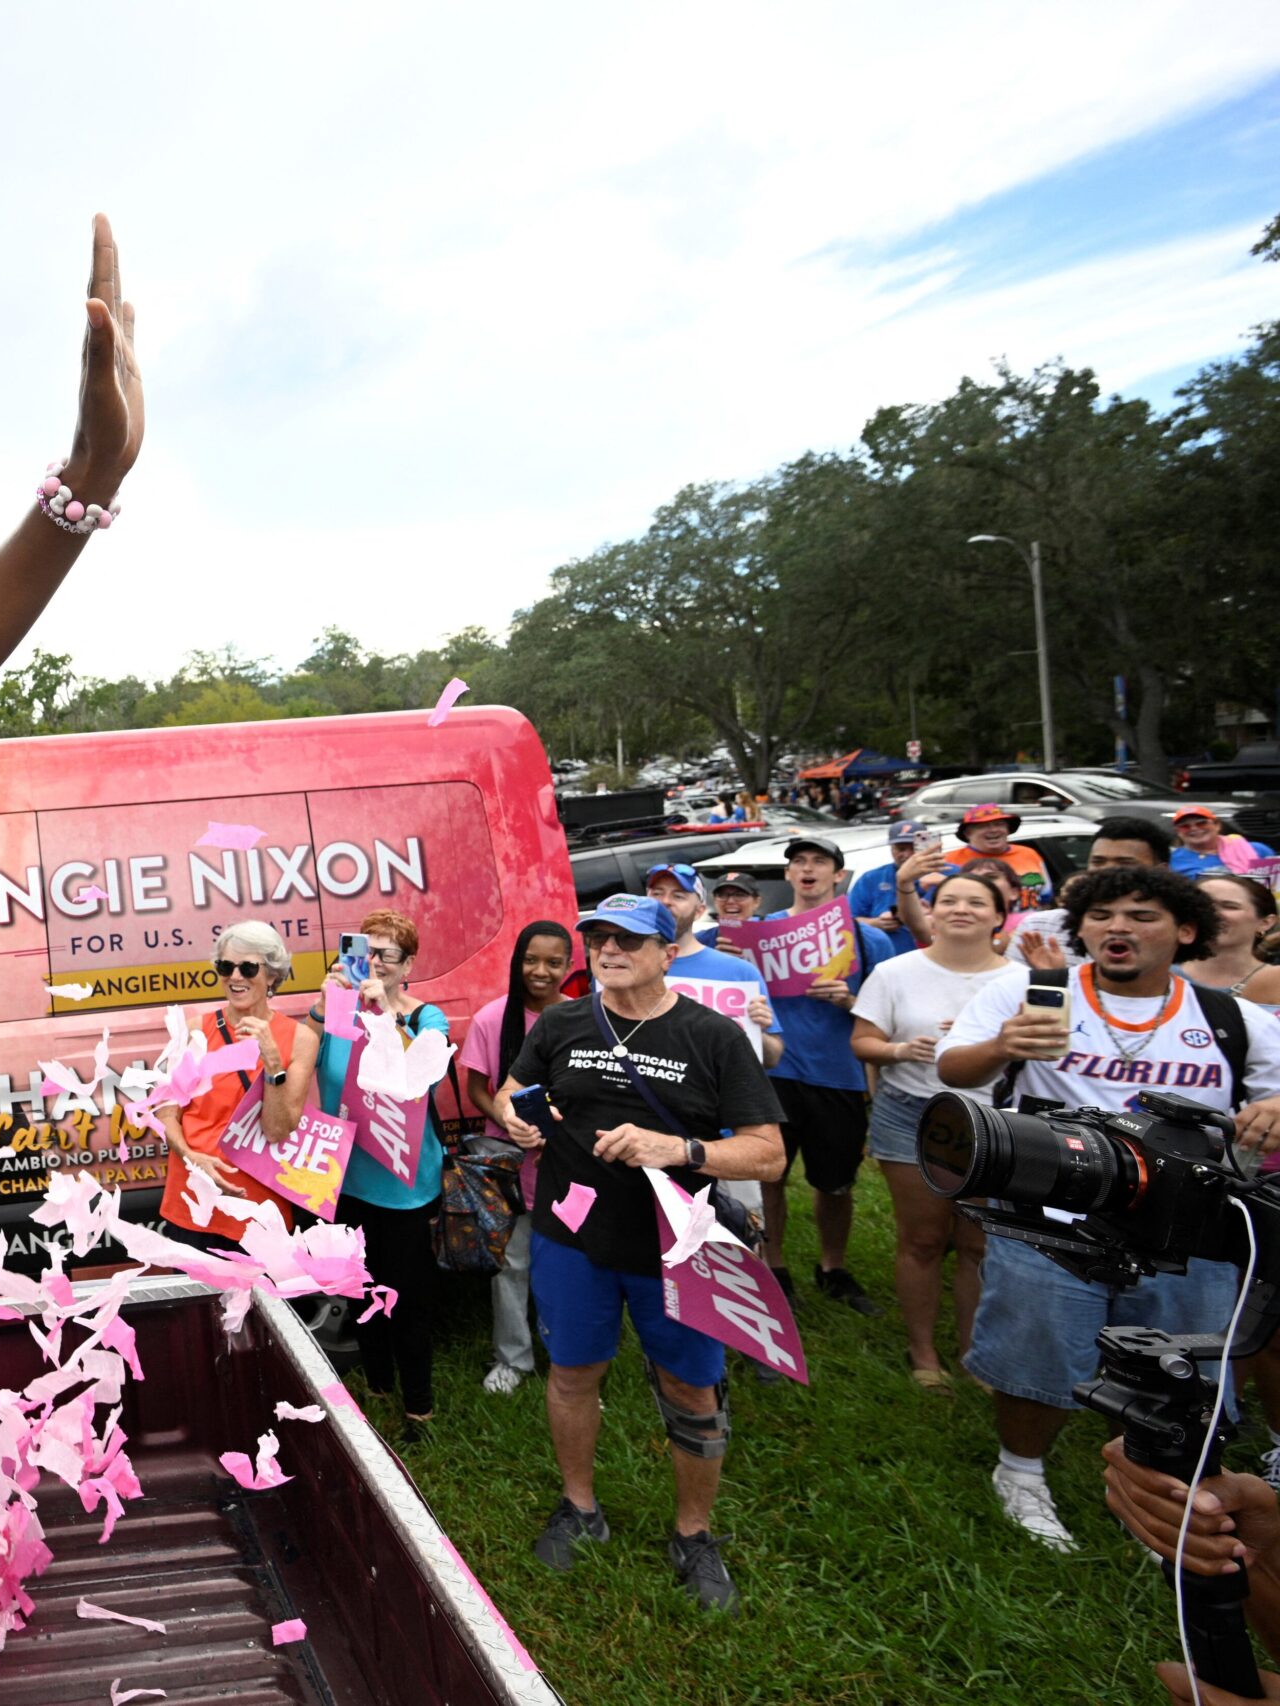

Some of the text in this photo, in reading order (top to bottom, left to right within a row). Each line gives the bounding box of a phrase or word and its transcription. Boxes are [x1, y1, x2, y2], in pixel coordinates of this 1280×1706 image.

[188, 837, 426, 906] NIXON
[71, 919, 310, 955] FOR U.S. STE
[758, 906, 842, 951] GATORS FOR
[568, 1059, 686, 1083] PRO-DEMCRACY
[570, 1049, 688, 1071] UNAPOLGETICALLY
[1056, 1051, 1222, 1088] FLORIDA
[310, 1121, 344, 1141] FOR
[1116, 1117, 1142, 1130] SONY
[222, 1101, 339, 1175] ANGIE
[66, 1151, 95, 1166] NO
[106, 1167, 128, 1184] PA
[131, 1164, 156, 1180] KA
